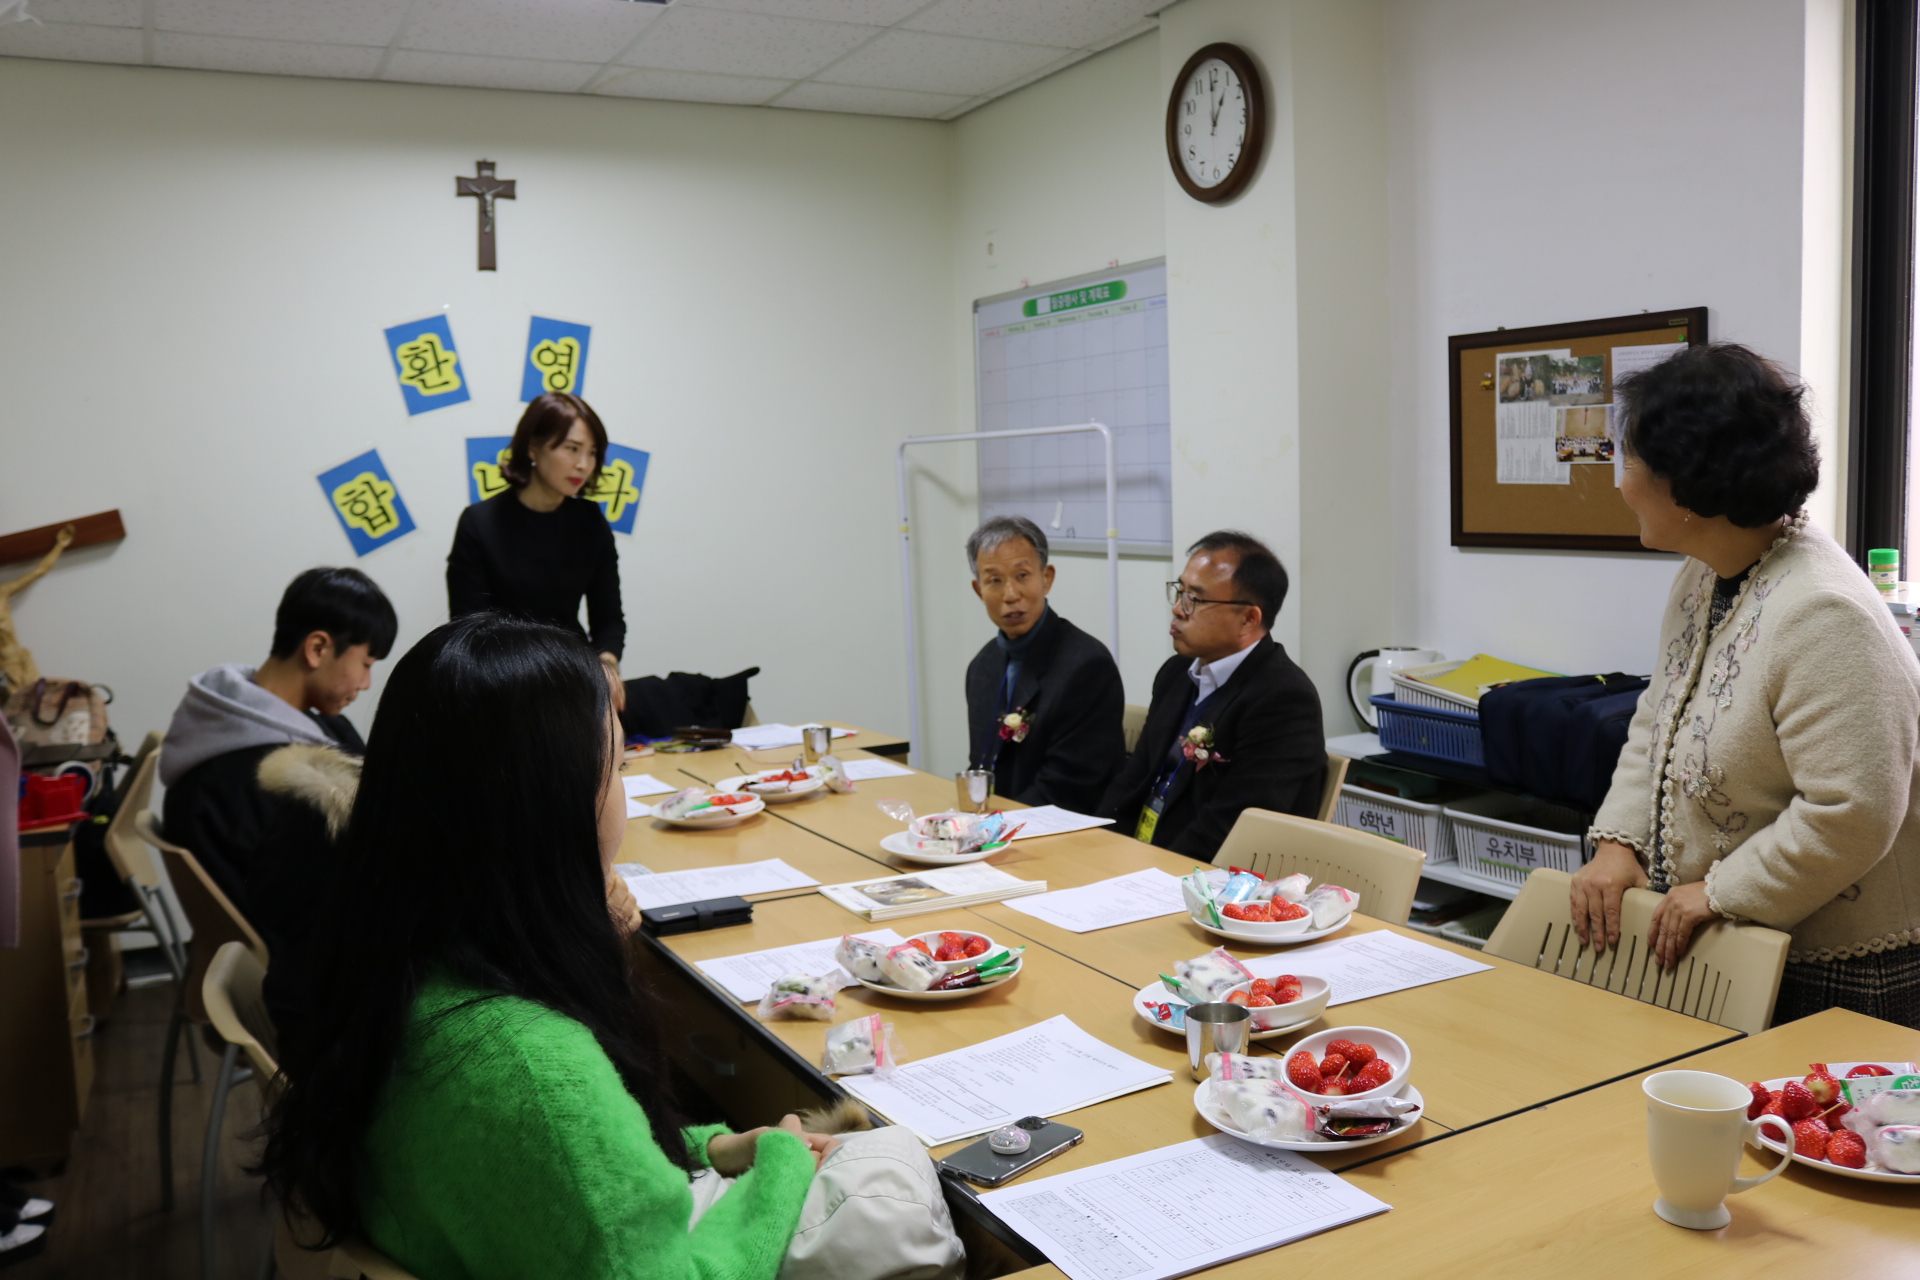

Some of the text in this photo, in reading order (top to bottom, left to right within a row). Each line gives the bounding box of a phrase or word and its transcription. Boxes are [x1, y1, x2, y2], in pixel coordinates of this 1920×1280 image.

[1194, 79, 1203, 96] 11
[1185, 99, 1196, 116] 10
[1184, 124, 1192, 140] 9
[1189, 145, 1196, 161] 8
[1227, 153, 1236, 171] 5
[1199, 161, 1206, 176] 7
[1213, 163, 1221, 181] 6
[402, 340, 450, 390] 환
[536, 344, 574, 391] 영
[340, 480, 391, 533] 합
[1359, 810, 1395, 836] 6학년
[1486, 837, 1537, 866] 유치부
